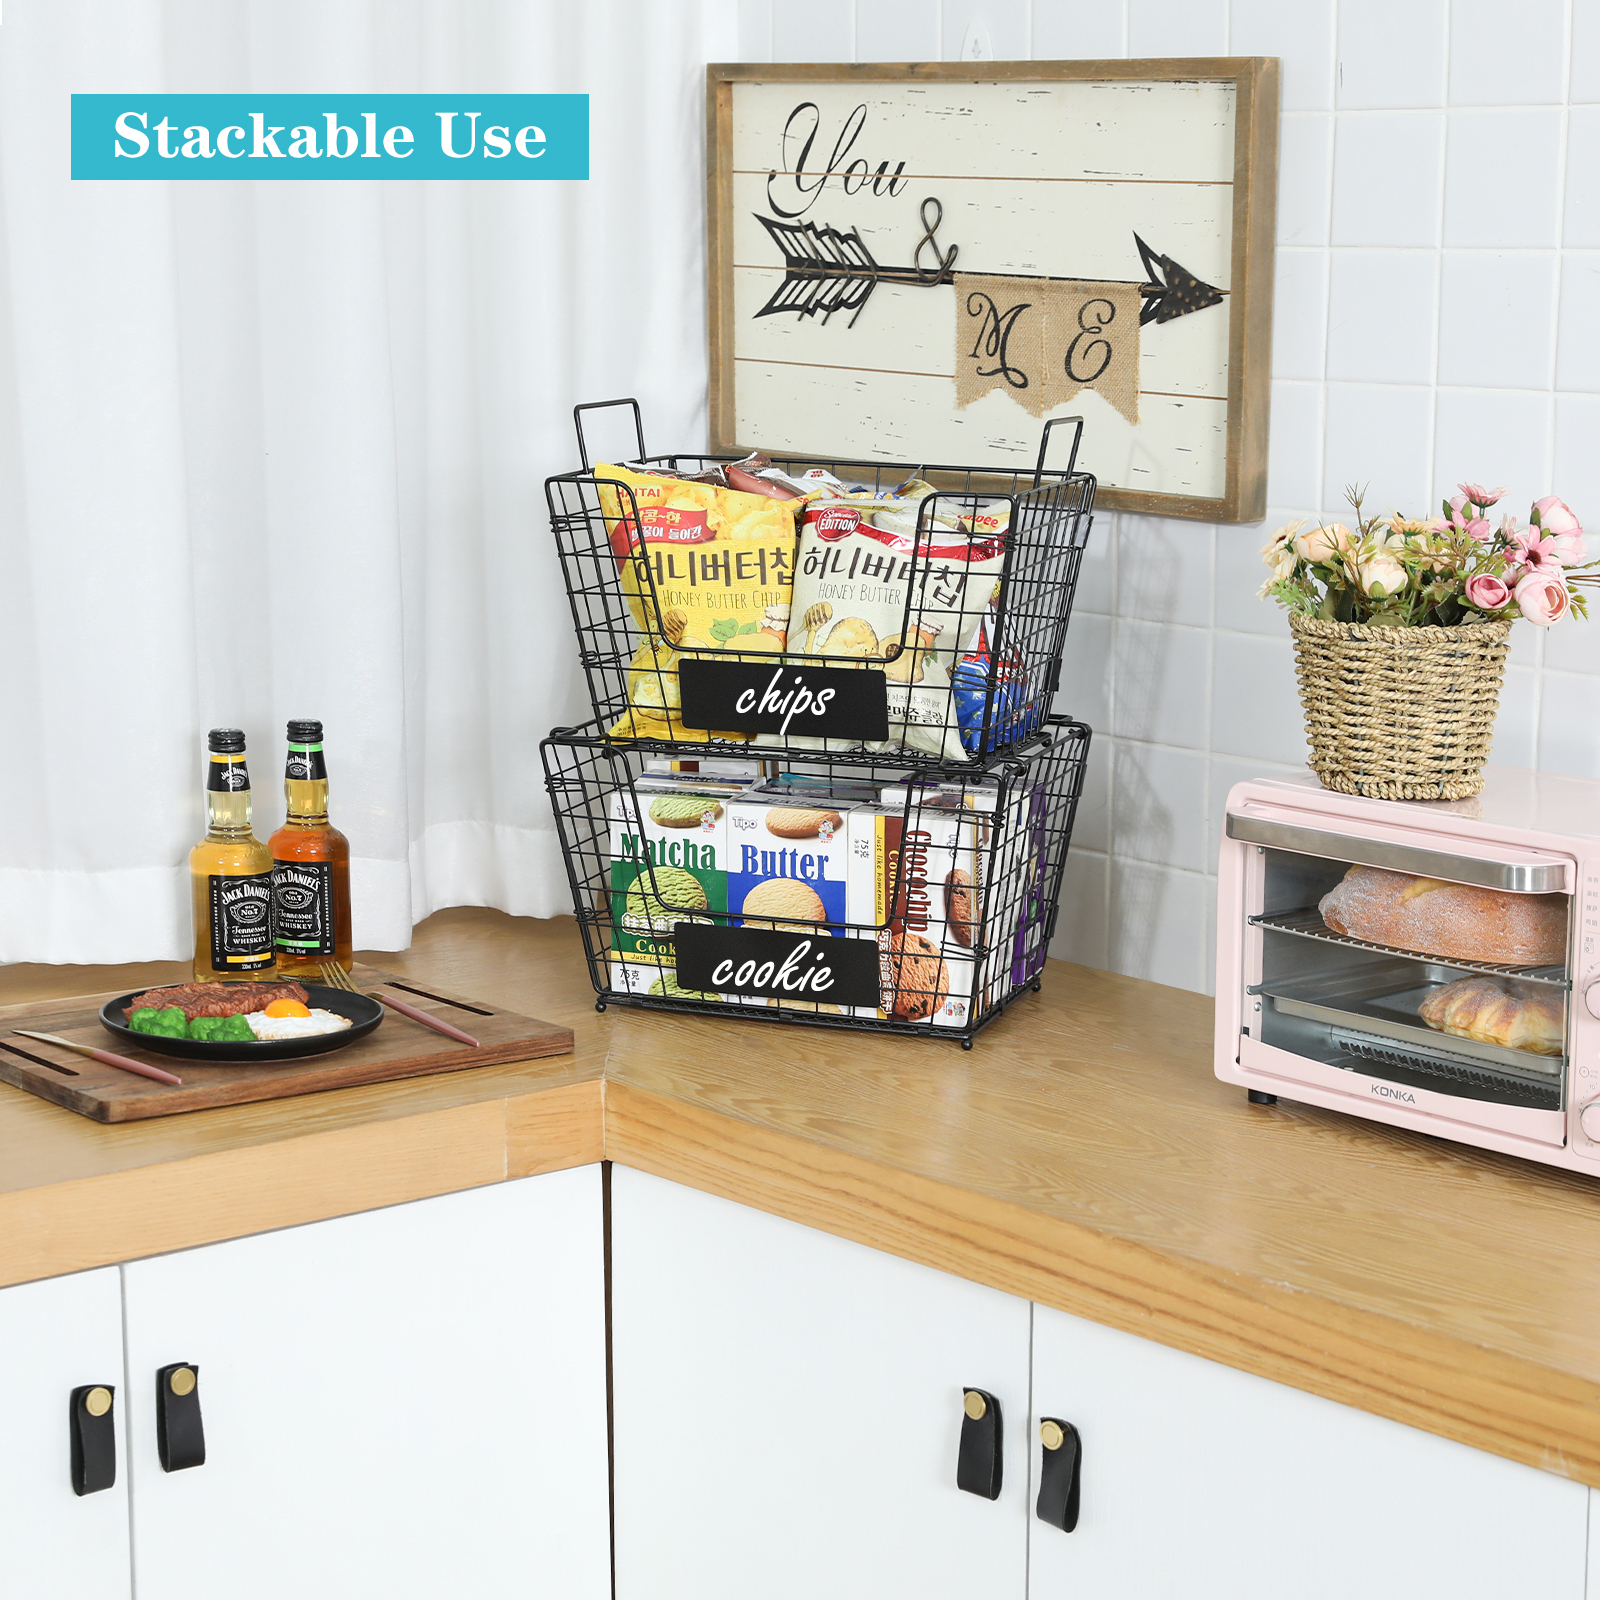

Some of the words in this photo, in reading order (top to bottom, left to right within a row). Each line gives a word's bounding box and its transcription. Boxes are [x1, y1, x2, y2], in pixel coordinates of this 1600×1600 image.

[767, 102, 908, 218] You
[914, 196, 959, 287] &
[820, 519, 856, 531] EDITION
[818, 583, 855, 600] HONEY
[860, 584, 901, 605] BUTTER
[735, 667, 836, 736] chips
[616, 805, 641, 819] Tp
[732, 815, 757, 830] Tipo
[620, 833, 716, 870] Matcha
[741, 844, 829, 881] Butter
[905, 830, 932, 931] Chocochip
[221, 887, 244, 905] JACK
[243, 883, 270, 902] DANIEL'S
[241, 908, 258, 916] No.7
[279, 908, 313, 919] Tennessee
[280, 921, 313, 930] WHISKEY
[232, 936, 266, 945] WHISKEY
[635, 938, 677, 955] Cook
[631, 953, 647, 961] Just
[711, 940, 835, 992] cookie
[1371, 1083, 1416, 1104] KONKA
